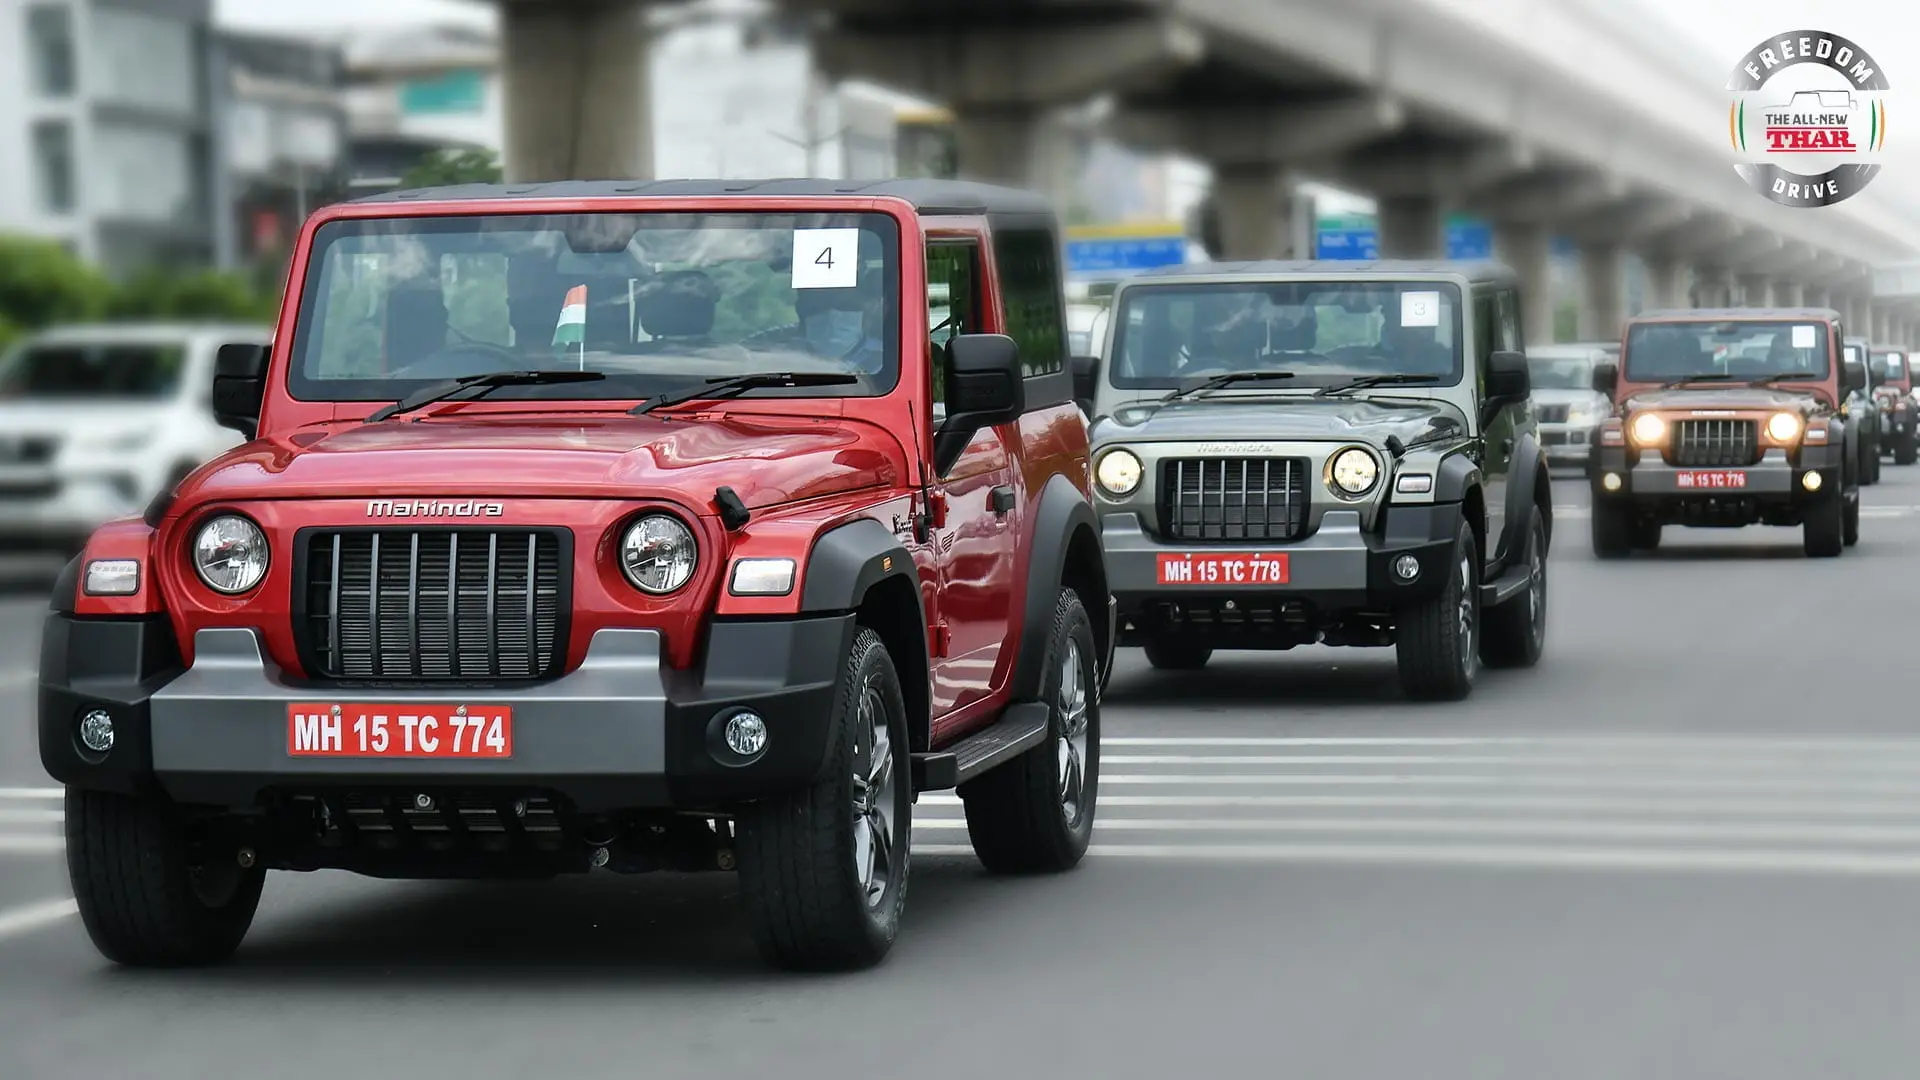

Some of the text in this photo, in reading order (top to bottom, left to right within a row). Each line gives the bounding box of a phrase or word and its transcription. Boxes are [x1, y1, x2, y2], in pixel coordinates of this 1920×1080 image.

[815, 247, 835, 269] 4
[1414, 301, 1426, 316] 3
[1678, 473, 1694, 487] MH
[1697, 473, 1709, 487] 15
[1710, 473, 1724, 487] TC
[367, 499, 504, 517] Mahindra
[1165, 560, 1280, 581] MH 15 TC 778
[294, 714, 505, 753] MH 15 TC 774
